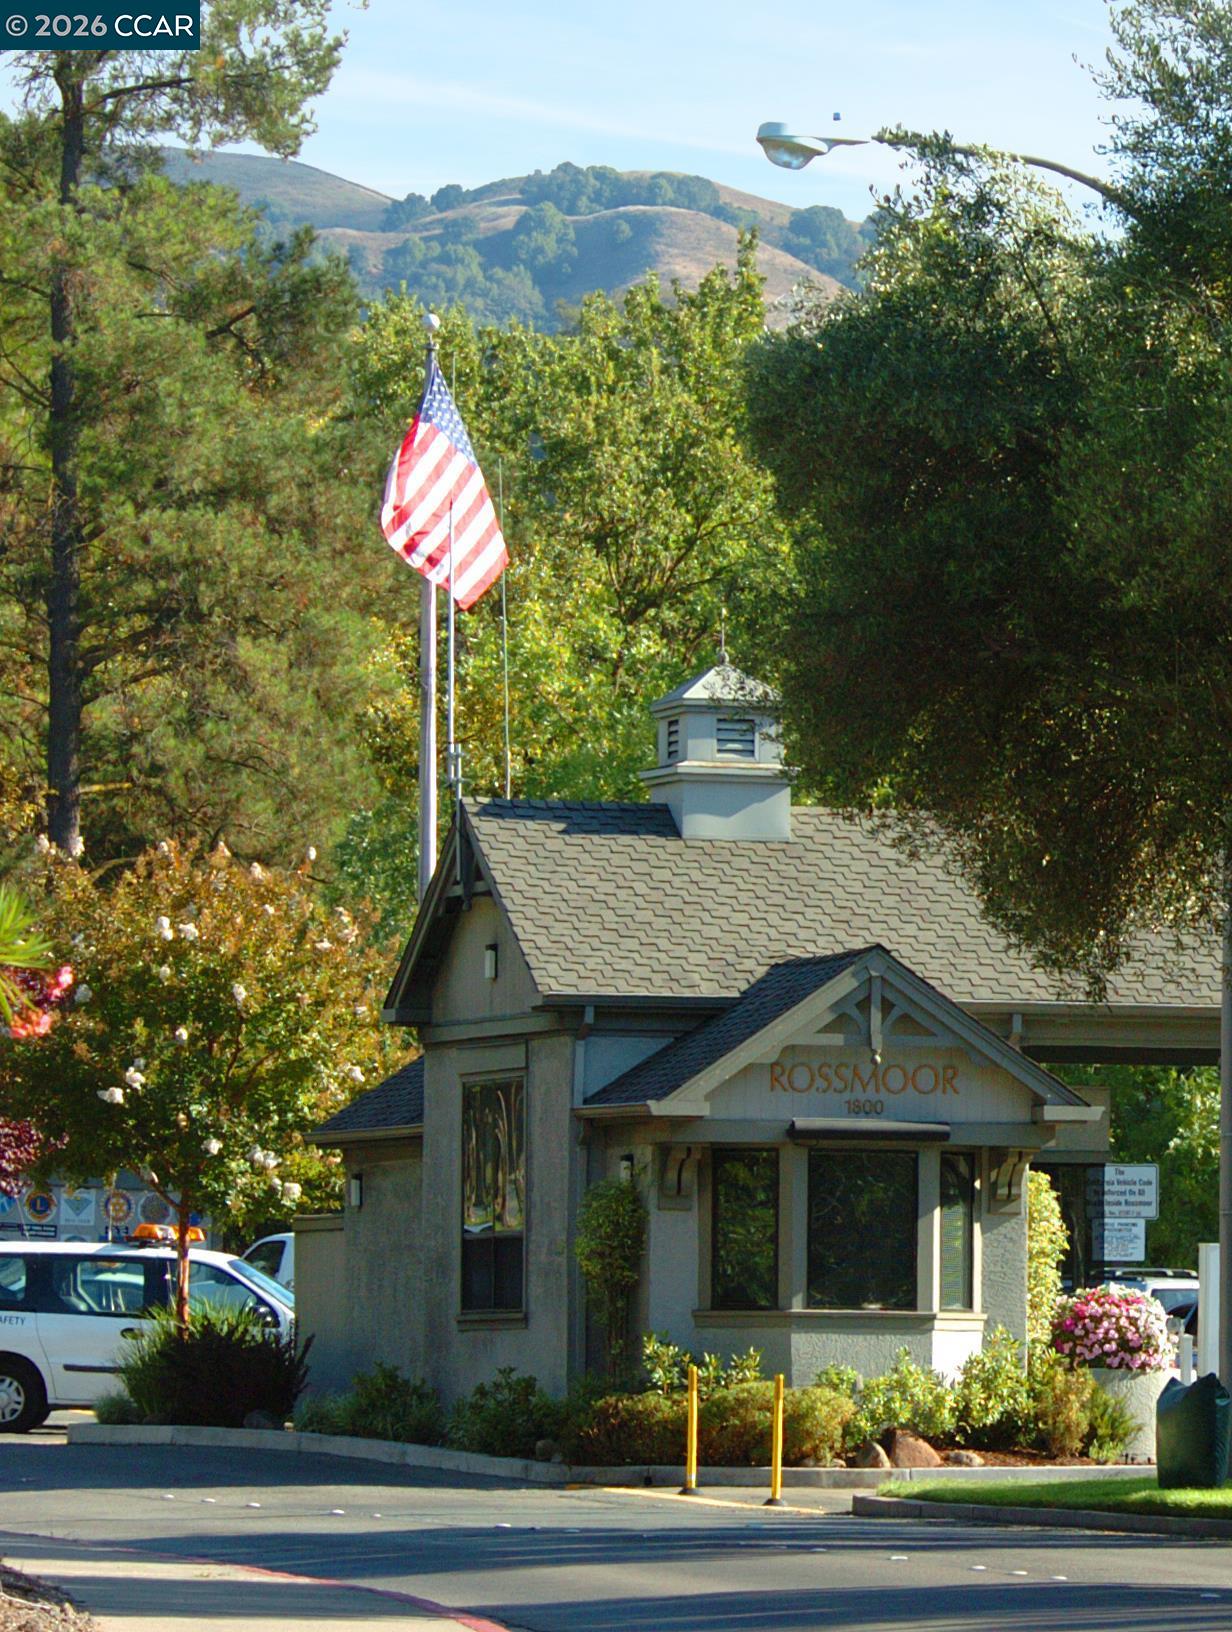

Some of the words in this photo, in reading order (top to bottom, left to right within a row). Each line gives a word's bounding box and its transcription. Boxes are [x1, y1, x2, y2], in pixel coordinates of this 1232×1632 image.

[769, 1062, 960, 1095] ROSSMOOR
[843, 1099, 884, 1115] 1800
[1115, 1168, 1125, 1176] The
[1139, 1178, 1152, 1186] Code
